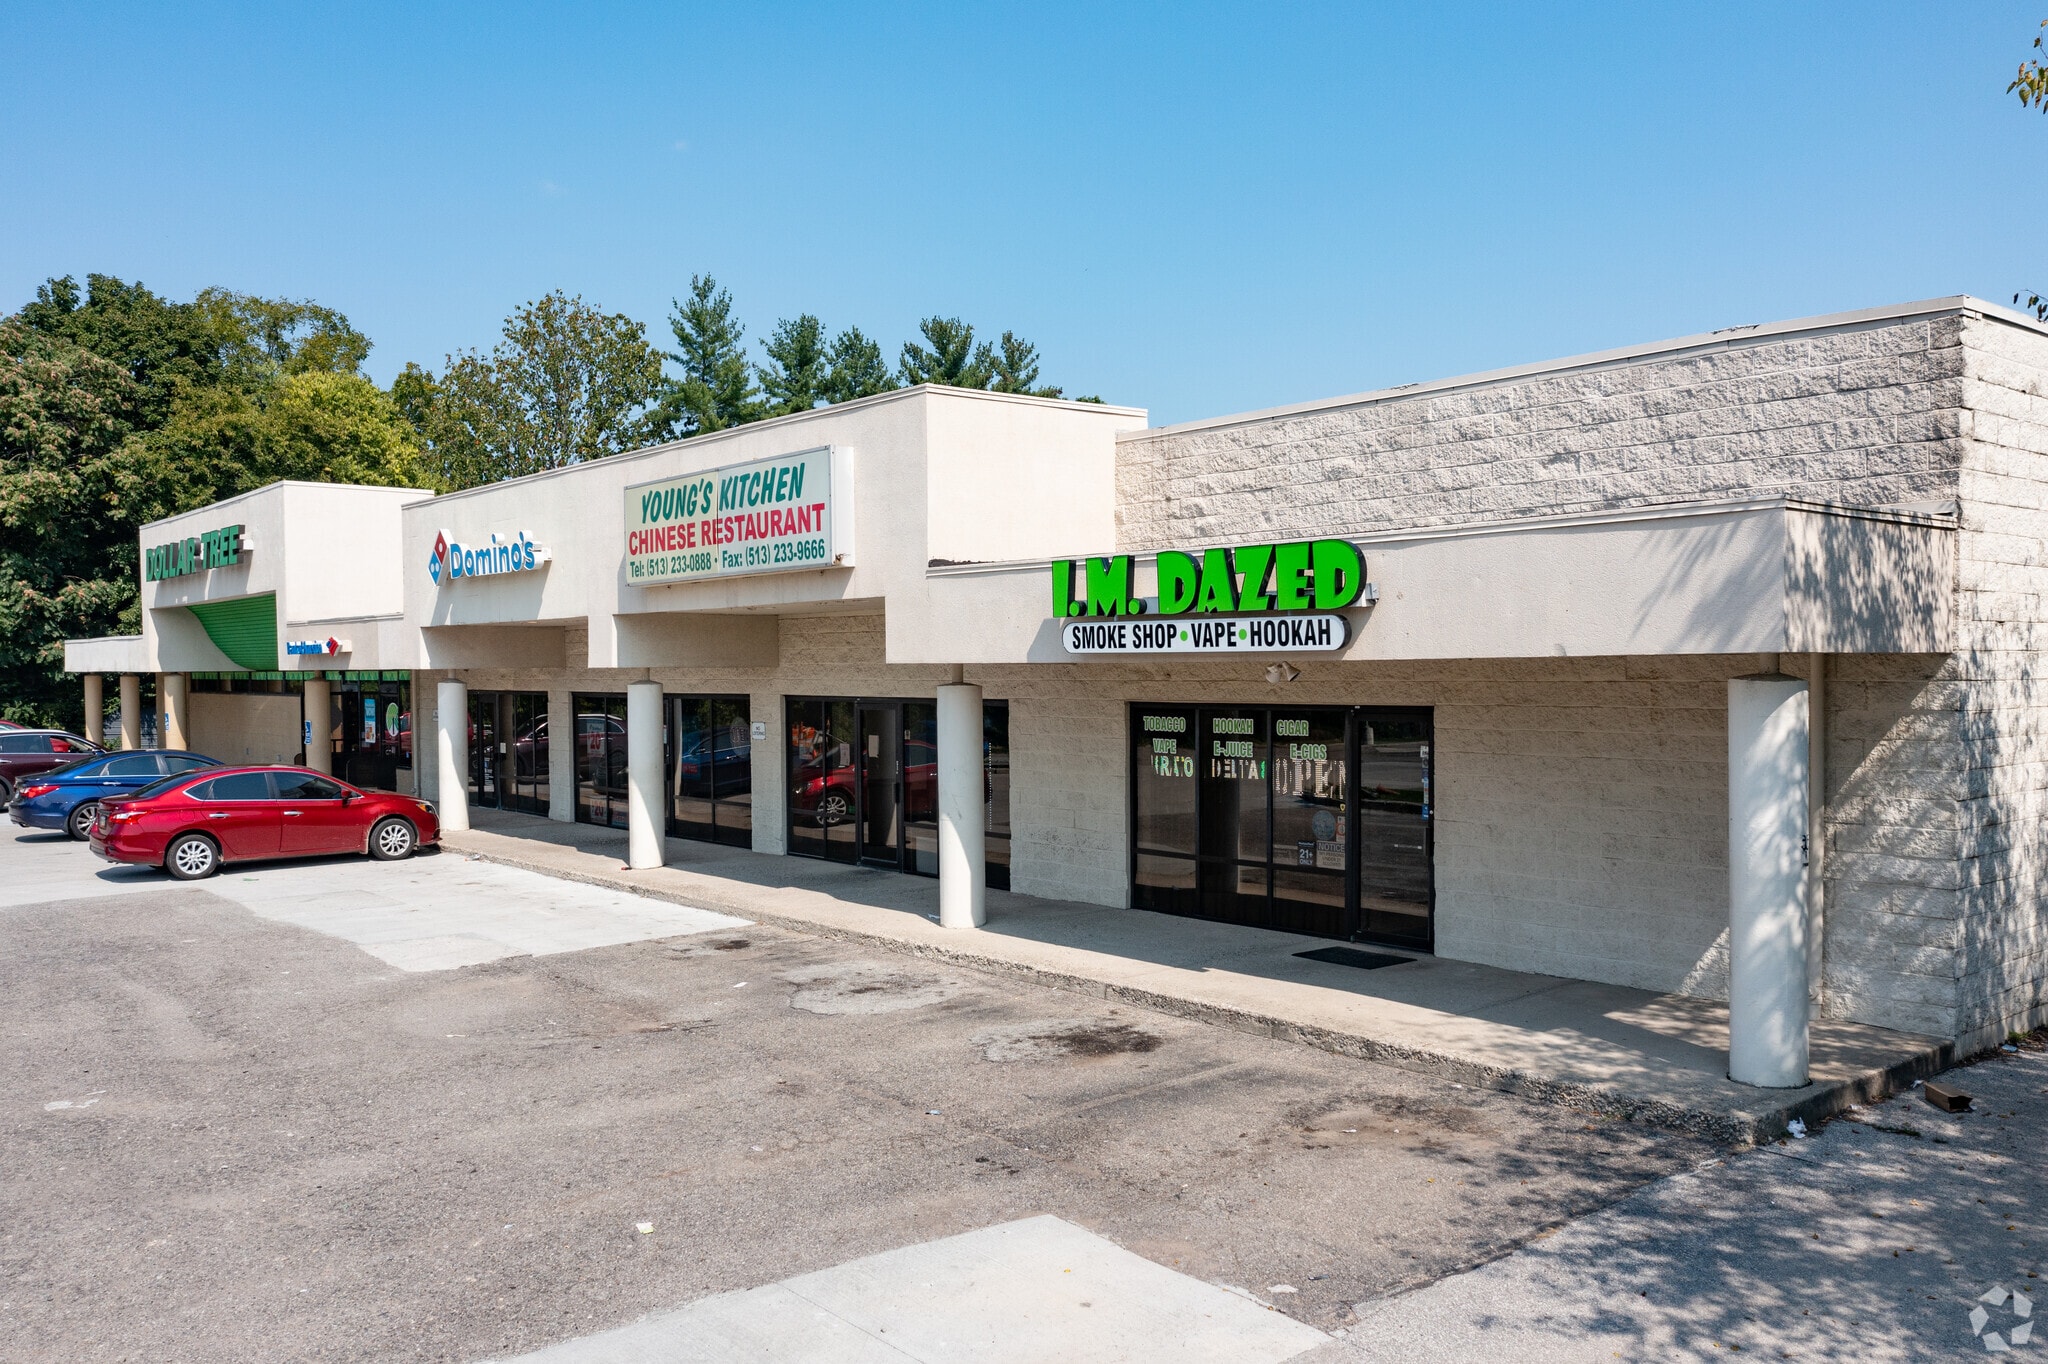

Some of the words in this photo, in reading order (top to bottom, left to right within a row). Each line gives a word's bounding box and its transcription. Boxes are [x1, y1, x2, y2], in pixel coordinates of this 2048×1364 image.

[642, 478, 713, 524] YOUNG'S
[718, 462, 805, 511] KITCHEN
[629, 521, 696, 556] CHINESE
[701, 503, 825, 546] RESTAURANT
[146, 537, 197, 582] DOLLAR
[201, 524, 242, 570] TREE
[449, 531, 535, 579] Domino's
[630, 560, 645, 578] Tel:
[646, 556, 669, 577] (513)
[671, 552, 711, 574] 233-0888
[722, 549, 743, 569] Fax:
[745, 543, 771, 566] (513)
[774, 539, 825, 563] 233-9666
[1052, 555, 1146, 617] I.M.
[1157, 539, 1366, 615] DAZED
[1072, 621, 1126, 650] SMOKE
[1132, 623, 1177, 649] SHOP
[1191, 621, 1236, 648] VAPE
[1250, 618, 1331, 647] HOOKAH
[1143, 716, 1186, 732] TOBACCO
[1213, 718, 1254, 734] HOOKAH
[1276, 720, 1309, 736] CIGAR
[1152, 738, 1177, 754] VAPE
[1213, 741, 1253, 757] E-JUICE
[1290, 743, 1327, 760] E-CIGS
[1300, 849, 1313, 859] 21+
[1318, 842, 1345, 853] NOTICE
